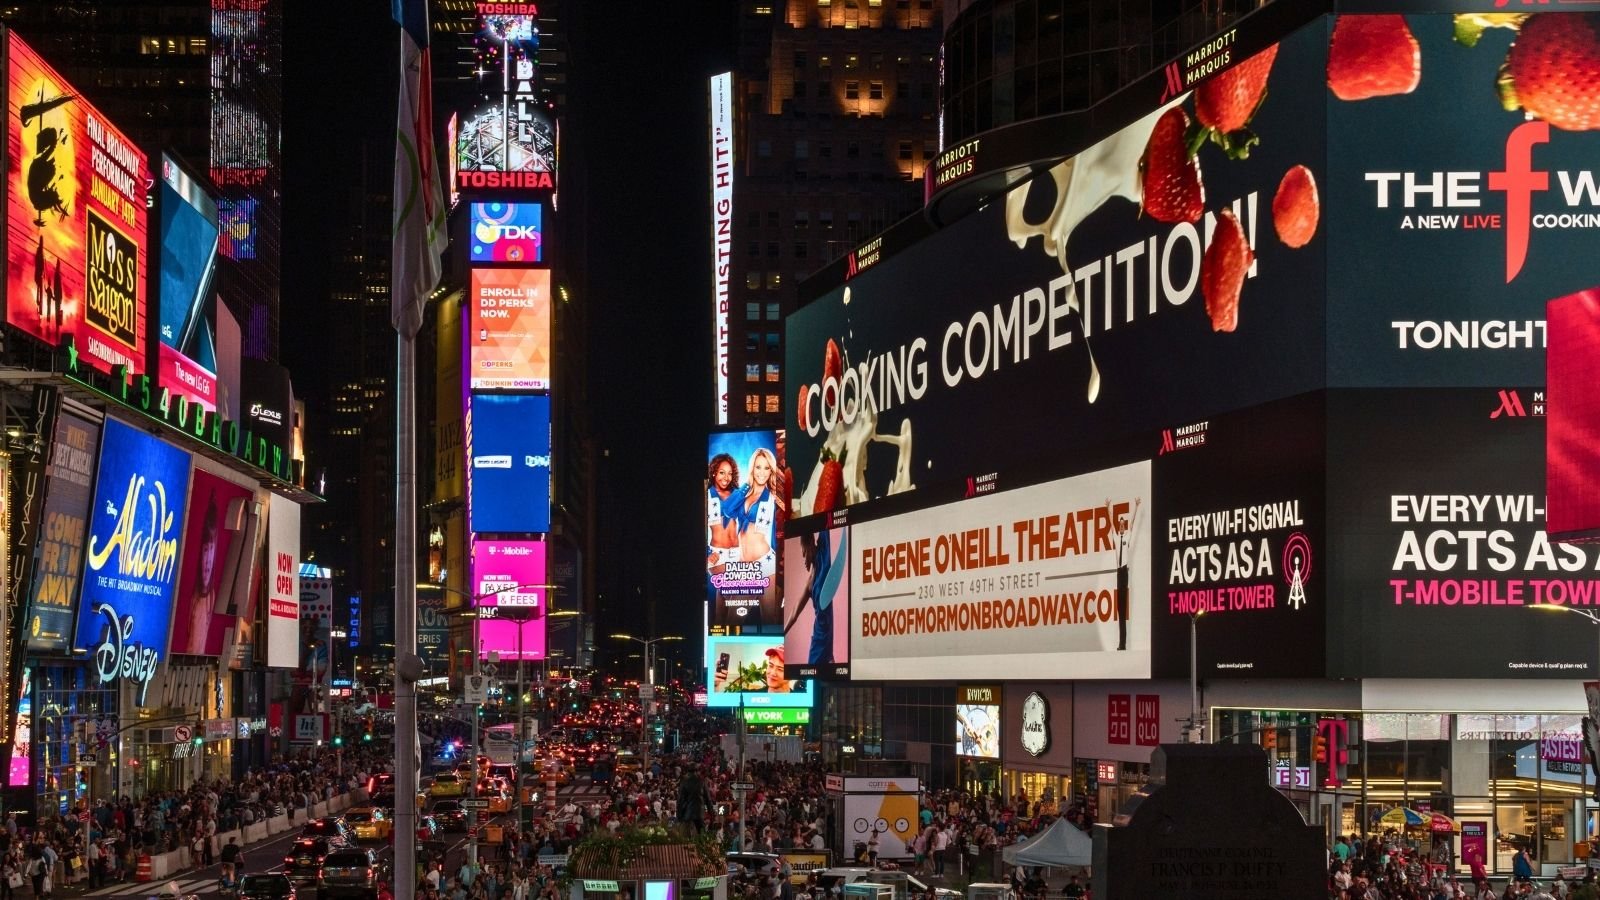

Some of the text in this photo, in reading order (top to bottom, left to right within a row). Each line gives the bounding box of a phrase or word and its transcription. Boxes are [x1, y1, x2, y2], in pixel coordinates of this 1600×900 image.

[476, 3, 537, 15] TOSHIBA
[1187, 28, 1237, 69] MARRIOTT
[1187, 50, 1231, 85] MARQUIS
[515, 60, 534, 142] BALL
[87, 113, 139, 178] FINAL BROADWAY
[936, 140, 980, 171] MARRIOTT
[91, 145, 135, 202] PERFORMANCE
[458, 171, 553, 188] TOSHIBA
[936, 159, 973, 187] MARQUIS
[91, 174, 135, 229] JANUARY 14TH
[1364, 172, 1481, 208] THE
[494, 225, 537, 240] TDK
[1400, 215, 1414, 229] A
[1418, 215, 1460, 229] NEW
[1463, 215, 1501, 229] LIVE
[858, 237, 882, 259] MARRIOTT
[858, 250, 879, 270] MARQUIS
[90, 267, 134, 334] Saigon
[480, 287, 538, 297] ENROLL IN
[480, 299, 534, 307] DD PERKS
[480, 309, 510, 318] NOW.
[1391, 320, 1547, 349] TONIGHT
[175, 361, 185, 382] The
[195, 374, 202, 390] LG
[805, 337, 928, 438] COOKING
[1176, 421, 1209, 437] MARRIOTT
[1176, 434, 1205, 448] MARQUIS
[195, 403, 293, 484] BROADWA
[976, 472, 998, 485] MARRIOTT
[976, 482, 995, 493] MARQUIS
[1390, 495, 1547, 522] EVERY WI-
[47, 511, 84, 546] COME
[89, 473, 177, 584] Aladdin
[1168, 499, 1304, 543] EVERY WI-FI SIGNAL
[862, 502, 1130, 585] EUGENE O'NEILL THEATRE
[1392, 530, 1517, 572] ACTS
[1524, 530, 1587, 572] AS
[278, 552, 292, 574] NOW
[726, 562, 760, 572] DALLAS
[1169, 537, 1273, 585] ACTS AS A
[98, 576, 107, 588] THE
[117, 579, 144, 593] BROADWAY
[144, 582, 162, 596] MUSICAL
[277, 574, 292, 596] OPEN
[723, 571, 762, 580] COWBOYS
[918, 572, 1041, 600] 230 WEST 49TH STREET
[36, 573, 76, 606] AWAY
[510, 595, 535, 605] FEES
[1168, 584, 1275, 614] T-MOBILE TOWER
[1390, 579, 1600, 605] T-MOBILE TOW
[418, 634, 441, 644] ERIES
[757, 711, 783, 720] YORK
[1138, 701, 1156, 719] UNI
[1138, 722, 1157, 743] QLO
[1541, 738, 1581, 760] FASTEST
[790, 861, 823, 870] eautiful
